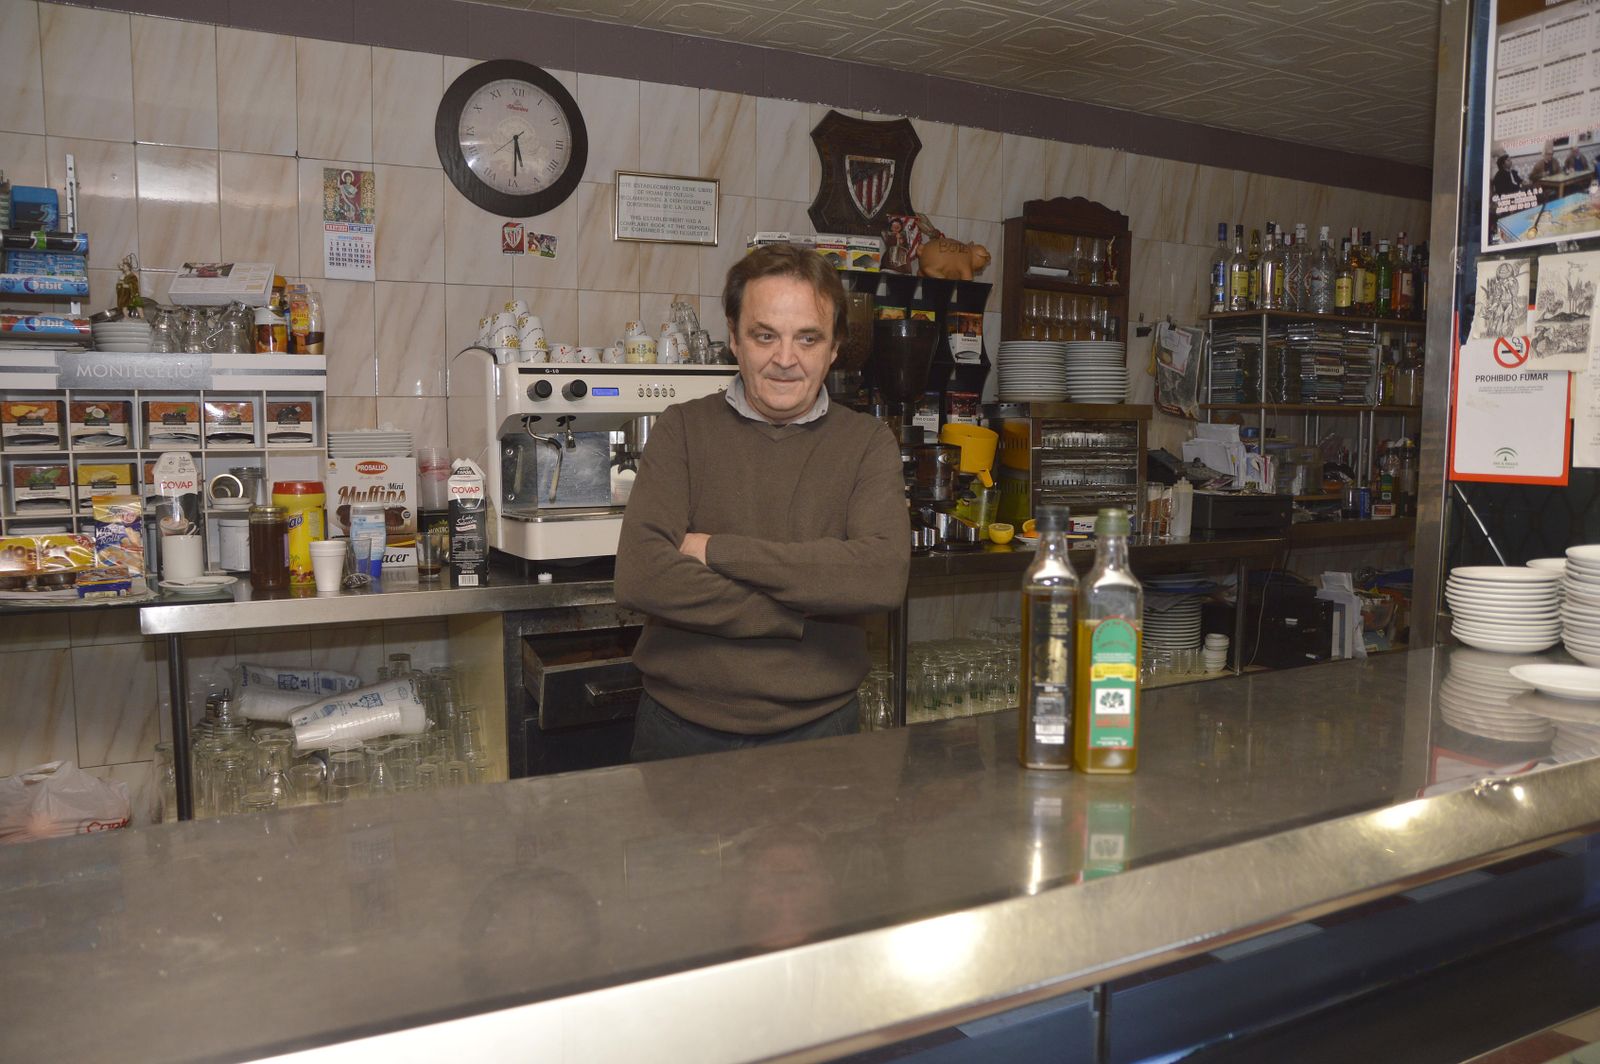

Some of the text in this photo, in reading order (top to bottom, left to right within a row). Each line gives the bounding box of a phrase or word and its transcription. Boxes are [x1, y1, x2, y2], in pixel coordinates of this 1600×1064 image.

[512, 87, 525, 97] XII
[32, 279, 64, 290] Orbit
[34, 318, 65, 328] Orbit
[76, 363, 194, 378] MONTECELIO
[1475, 373, 1548, 382] PROHIBIDO FUMAR
[160, 481, 193, 490] COVAP
[338, 486, 407, 504] Muffins
[382, 553, 409, 563] acer
